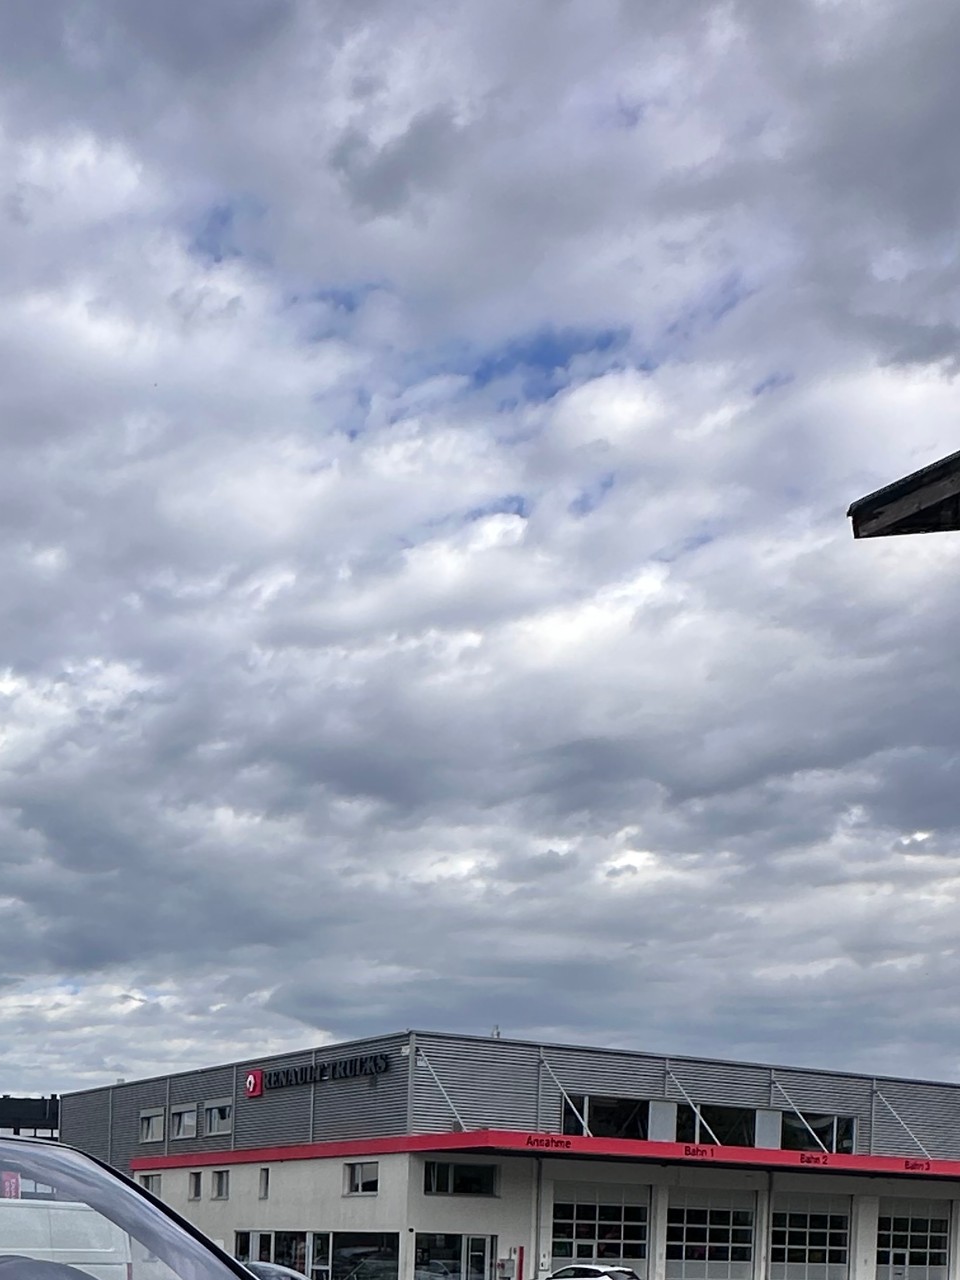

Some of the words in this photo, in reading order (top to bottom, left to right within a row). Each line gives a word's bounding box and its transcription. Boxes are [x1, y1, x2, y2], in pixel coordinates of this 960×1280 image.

[263, 1063, 327, 1090] RENAULT
[526, 1135, 572, 1149] Annahme
[684, 1145, 708, 1157] Bahn
[800, 1153, 820, 1165] Bahn
[905, 1160, 924, 1170] Bahn
